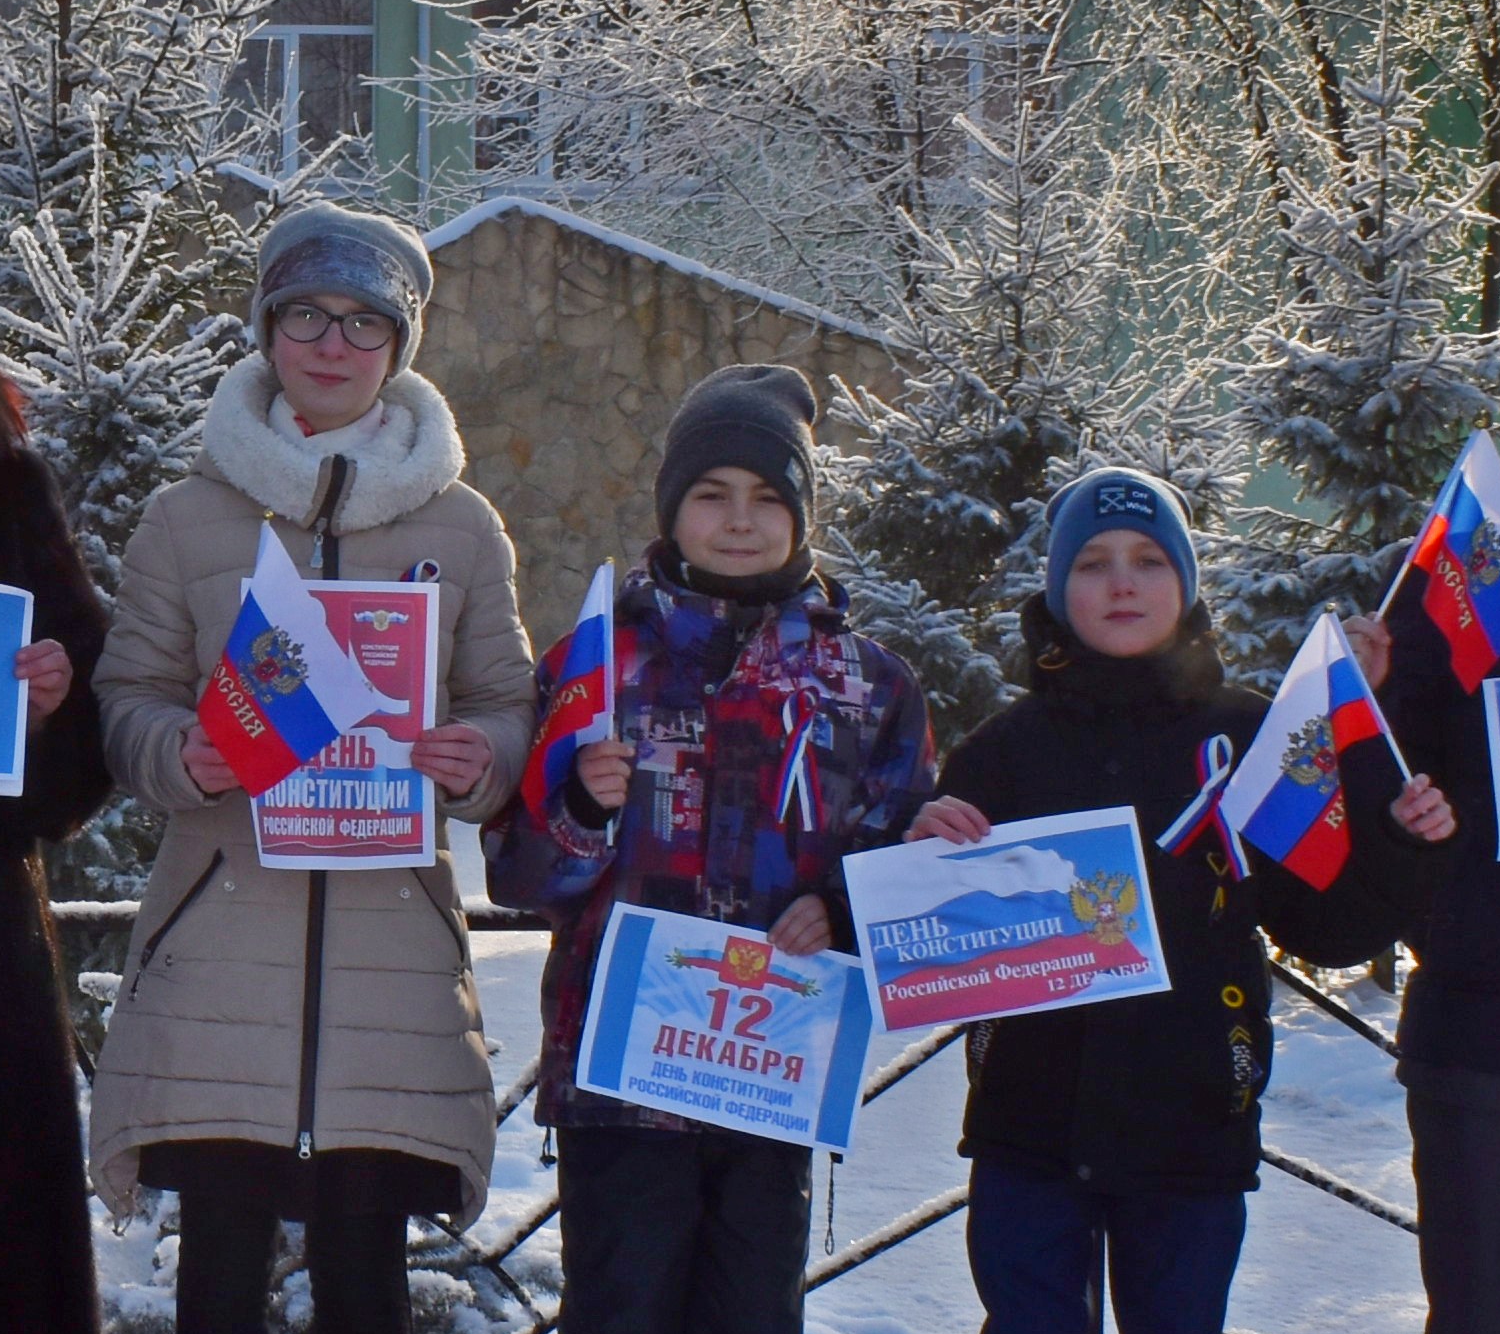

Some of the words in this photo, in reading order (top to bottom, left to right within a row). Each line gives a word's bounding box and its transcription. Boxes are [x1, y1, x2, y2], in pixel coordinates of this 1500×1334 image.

[264, 778, 410, 815] КОНСТИТУЦИИ
[263, 815, 335, 836] РОССИЙСКОЙ
[339, 817, 412, 839] ФЕДЕРАЦИИ
[872, 916, 949, 950] ДЕНЬ
[896, 917, 1063, 963] КОНСТИТУЦИИ
[885, 971, 991, 1001] Российской
[995, 952, 1096, 981] Федерации
[1048, 978, 1066, 992] 12
[706, 987, 773, 1042] 12
[653, 1024, 805, 1083] ДЕКАБРЯ
[628, 1075, 721, 1112] РОССИЙСКОЙ
[725, 1100, 810, 1133] ФЕДЕРАЦИИ
[651, 1061, 688, 1082] ДЕНЬ
[692, 1070, 793, 1108] КОНСТИТУЦИИ
